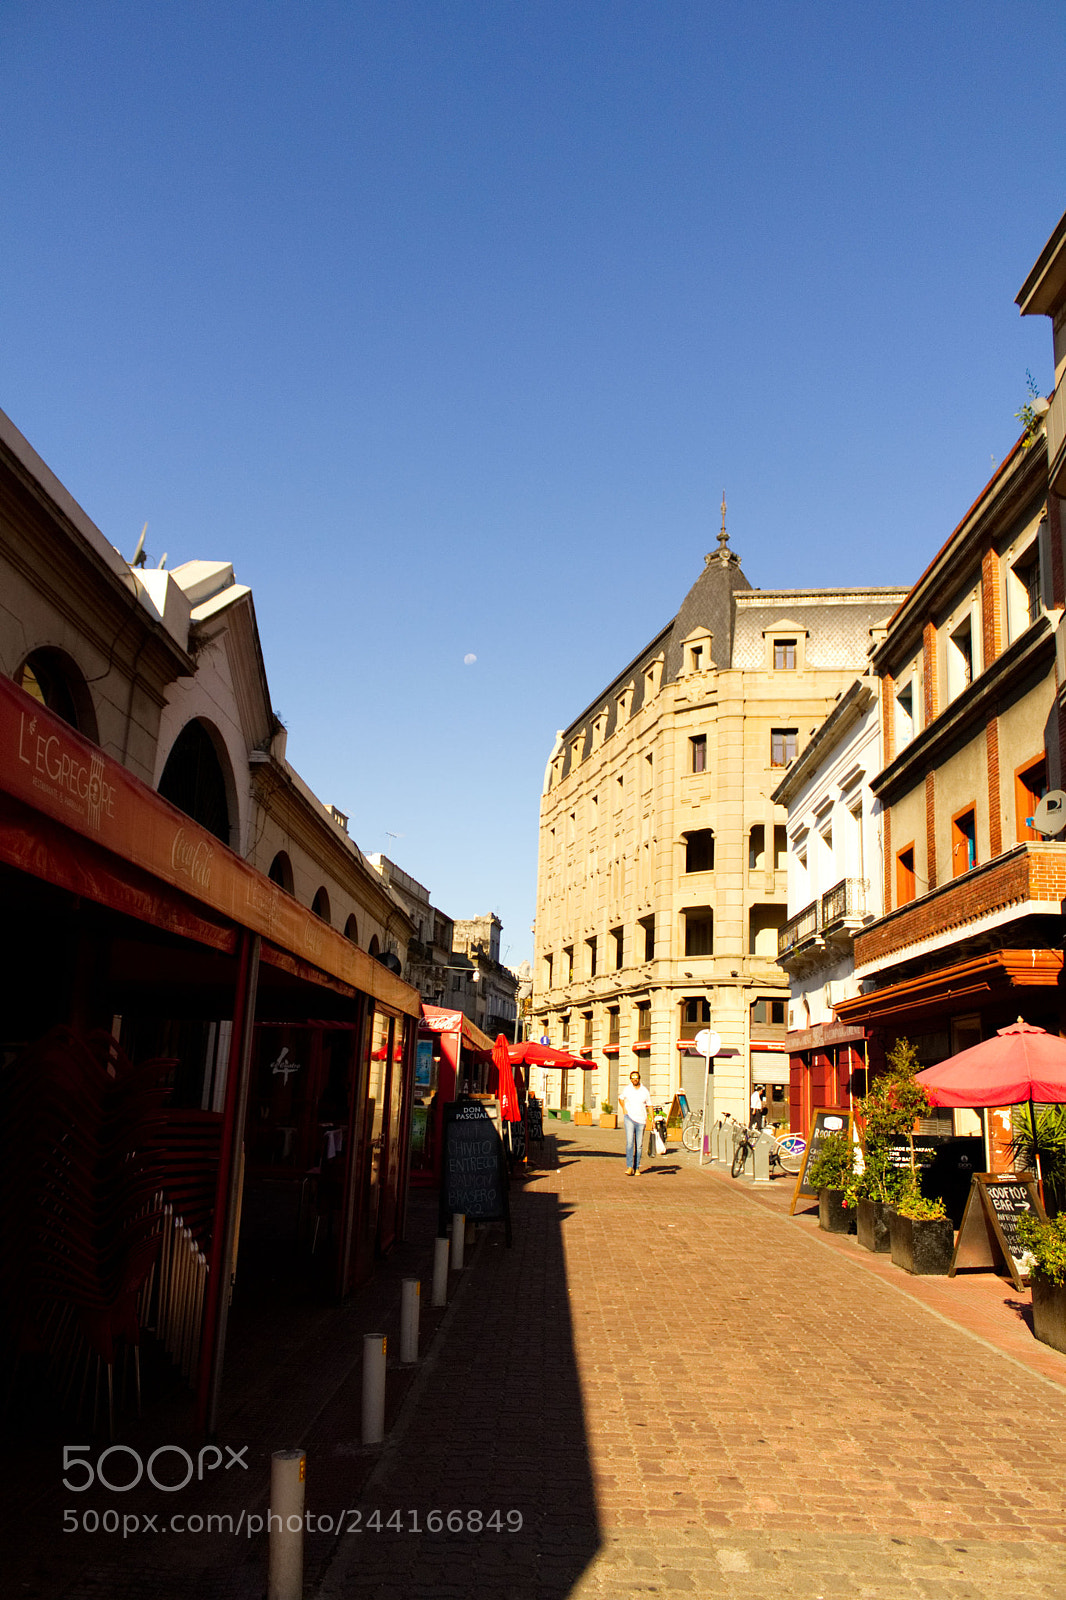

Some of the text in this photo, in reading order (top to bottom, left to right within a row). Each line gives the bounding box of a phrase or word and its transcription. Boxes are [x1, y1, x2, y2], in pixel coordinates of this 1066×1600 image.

[463, 1106, 481, 1114] DON
[455, 1112, 489, 1120] PASCUAL
[987, 1186, 1028, 1200] ROOFTOP
[993, 1199, 1015, 1212] BAR
